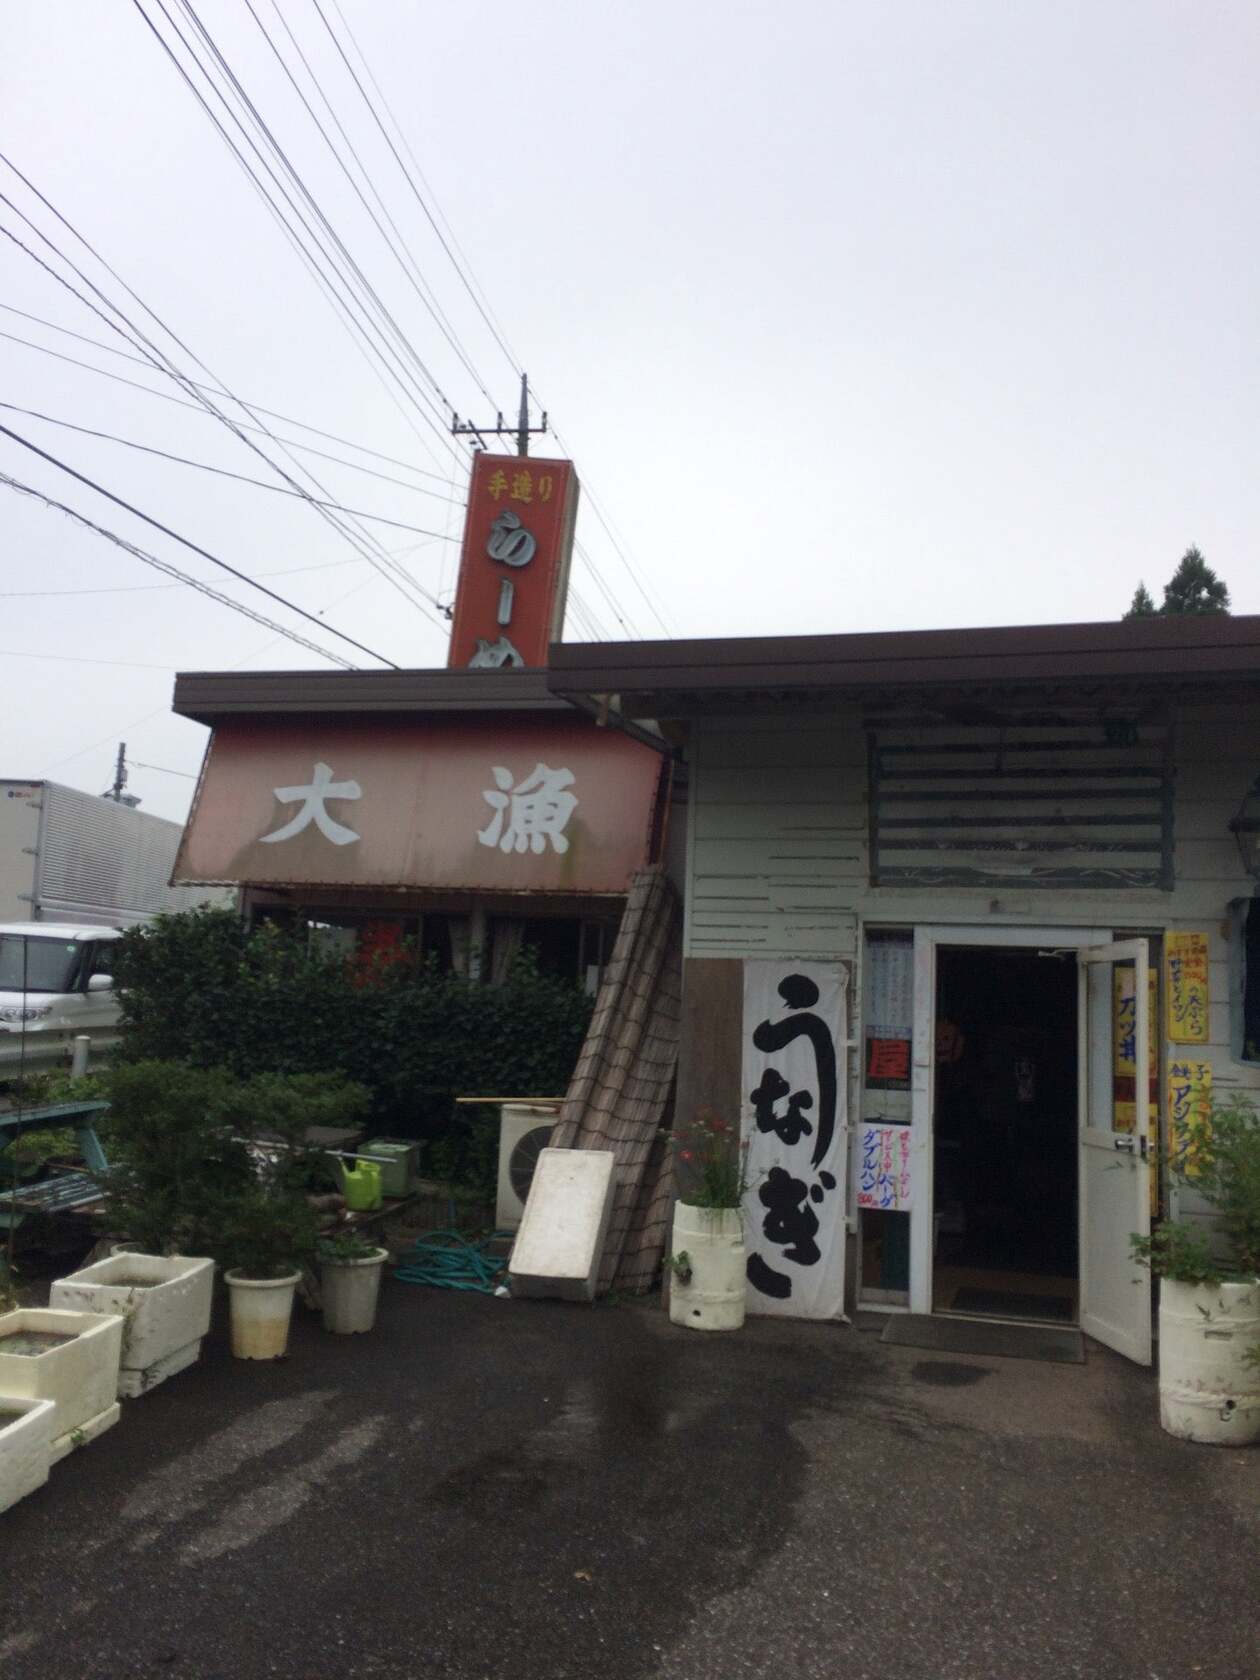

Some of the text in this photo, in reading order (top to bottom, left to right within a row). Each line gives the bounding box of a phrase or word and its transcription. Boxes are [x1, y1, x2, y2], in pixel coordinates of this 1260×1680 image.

[488, 470, 553, 504] 手造り
[260, 762, 579, 855] 大漁
[745, 973, 837, 1299] うなぎ
